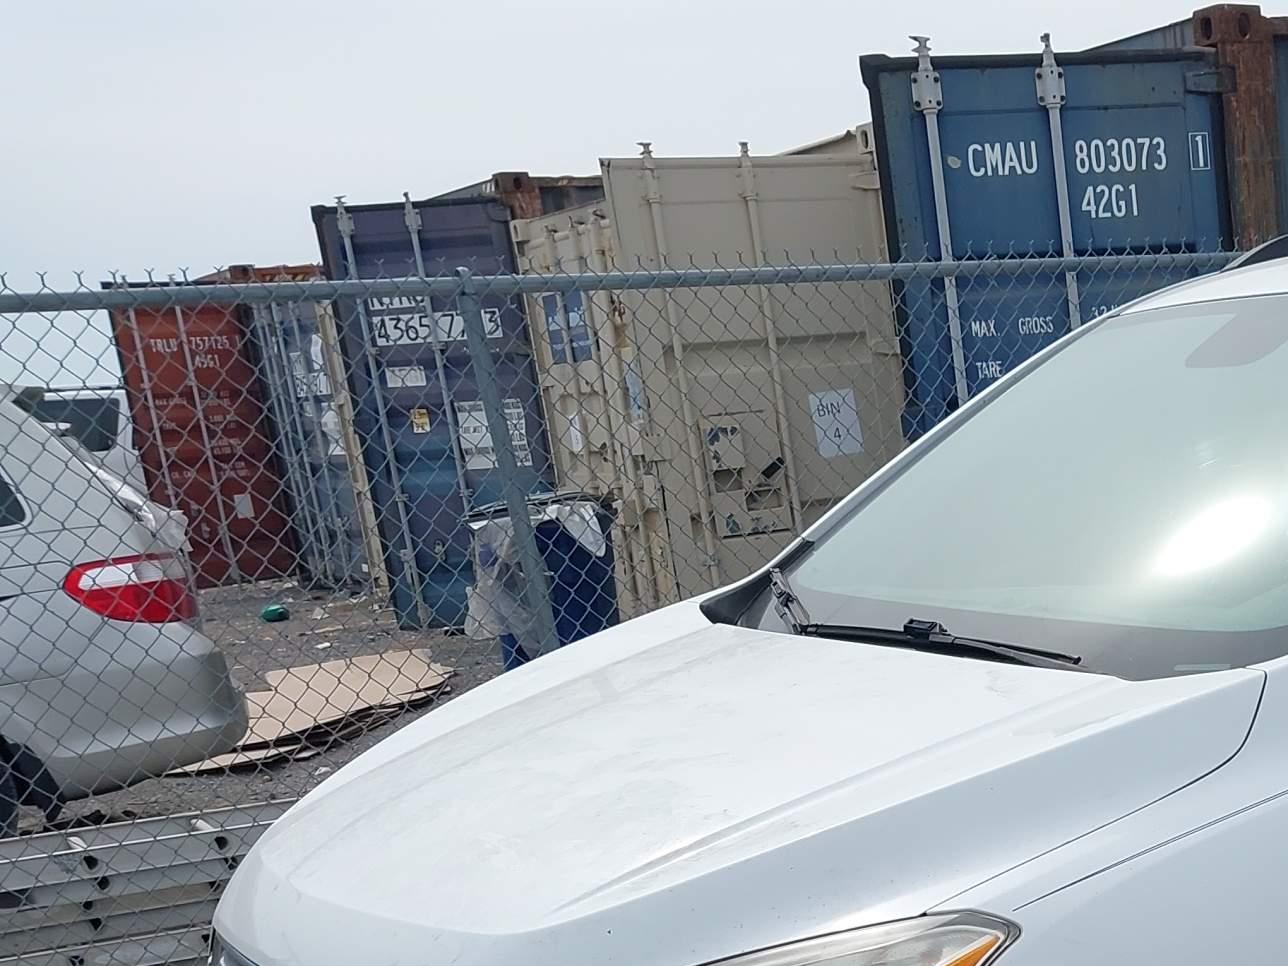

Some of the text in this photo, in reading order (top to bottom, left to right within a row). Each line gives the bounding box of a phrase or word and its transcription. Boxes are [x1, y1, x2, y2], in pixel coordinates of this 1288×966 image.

[967, 134, 1206, 177] CMAU 803073 1
[1081, 183, 1139, 219] 42G1
[971, 316, 1054, 337] MAX. GROSS
[975, 361, 1002, 379] TARE
[816, 402, 841, 418] BIN
[833, 427, 842, 440] 4
